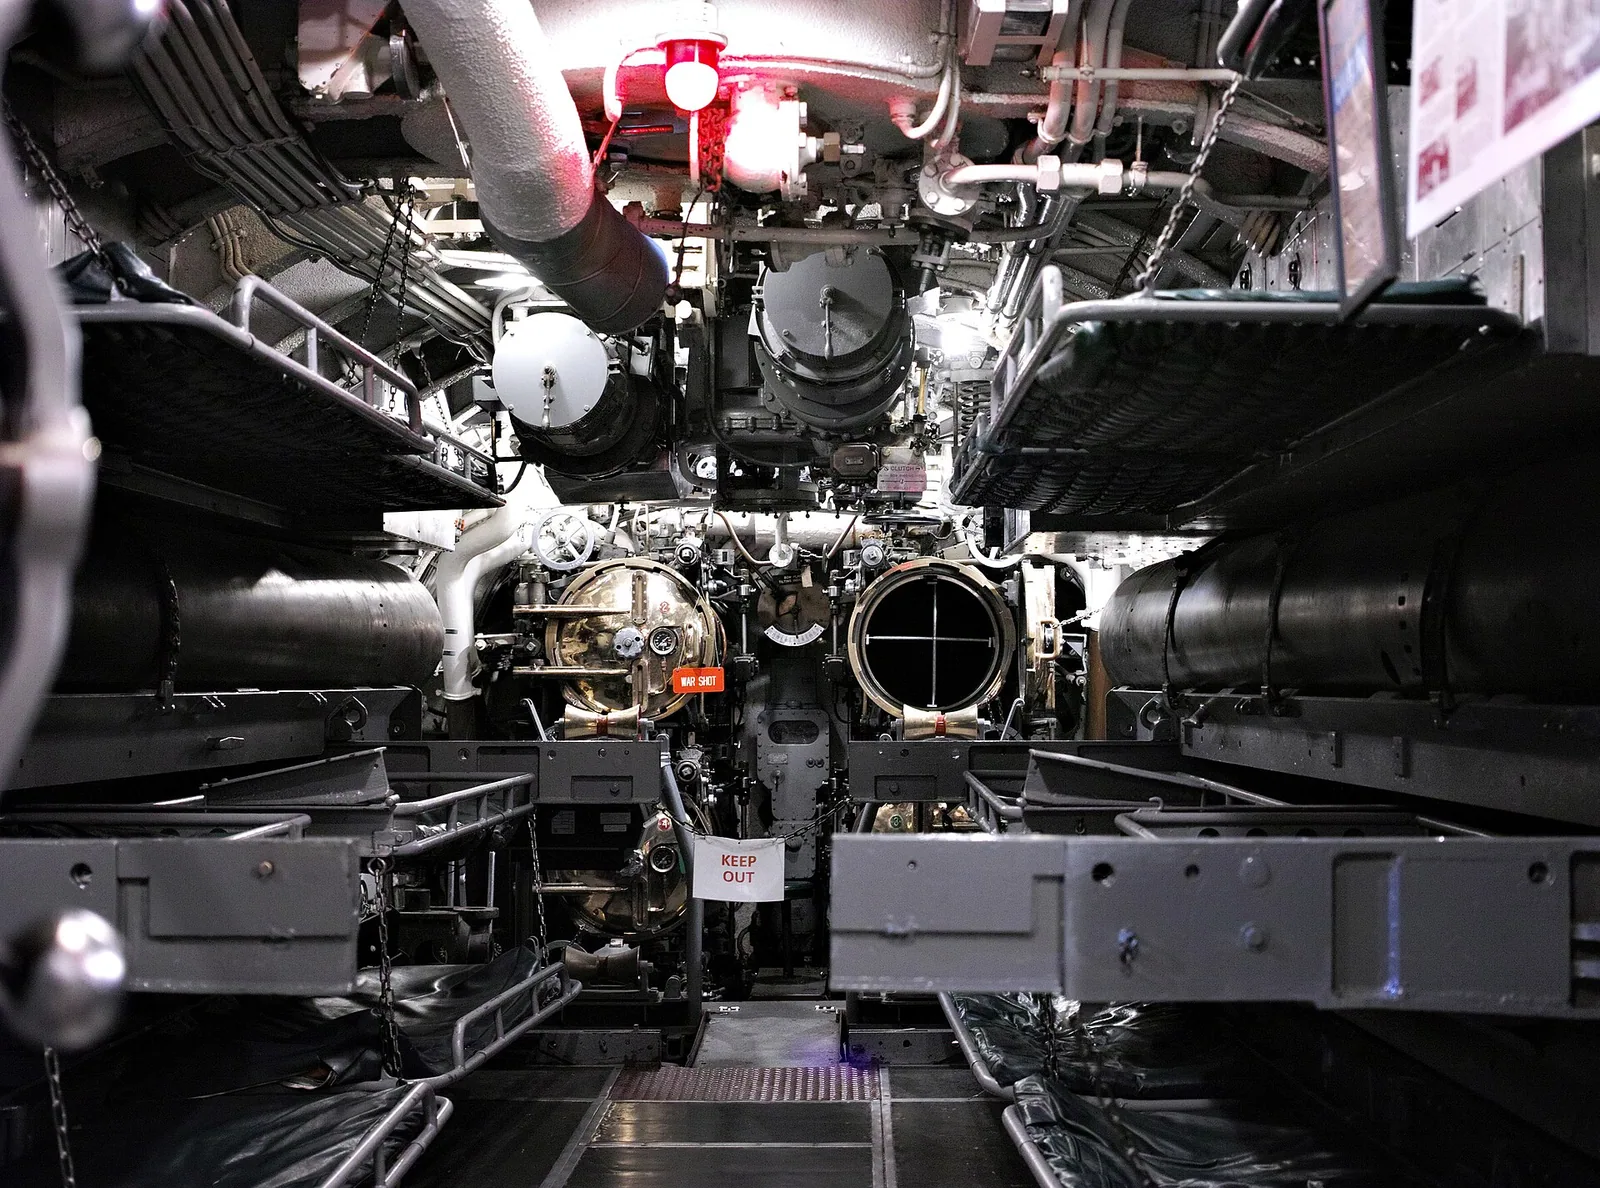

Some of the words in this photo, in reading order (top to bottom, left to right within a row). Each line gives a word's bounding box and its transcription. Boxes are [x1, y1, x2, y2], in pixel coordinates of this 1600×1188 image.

[681, 676, 696, 687] WAR
[698, 675, 717, 687] SHOT
[721, 854, 757, 867] KEEP
[723, 871, 755, 883] OUT
